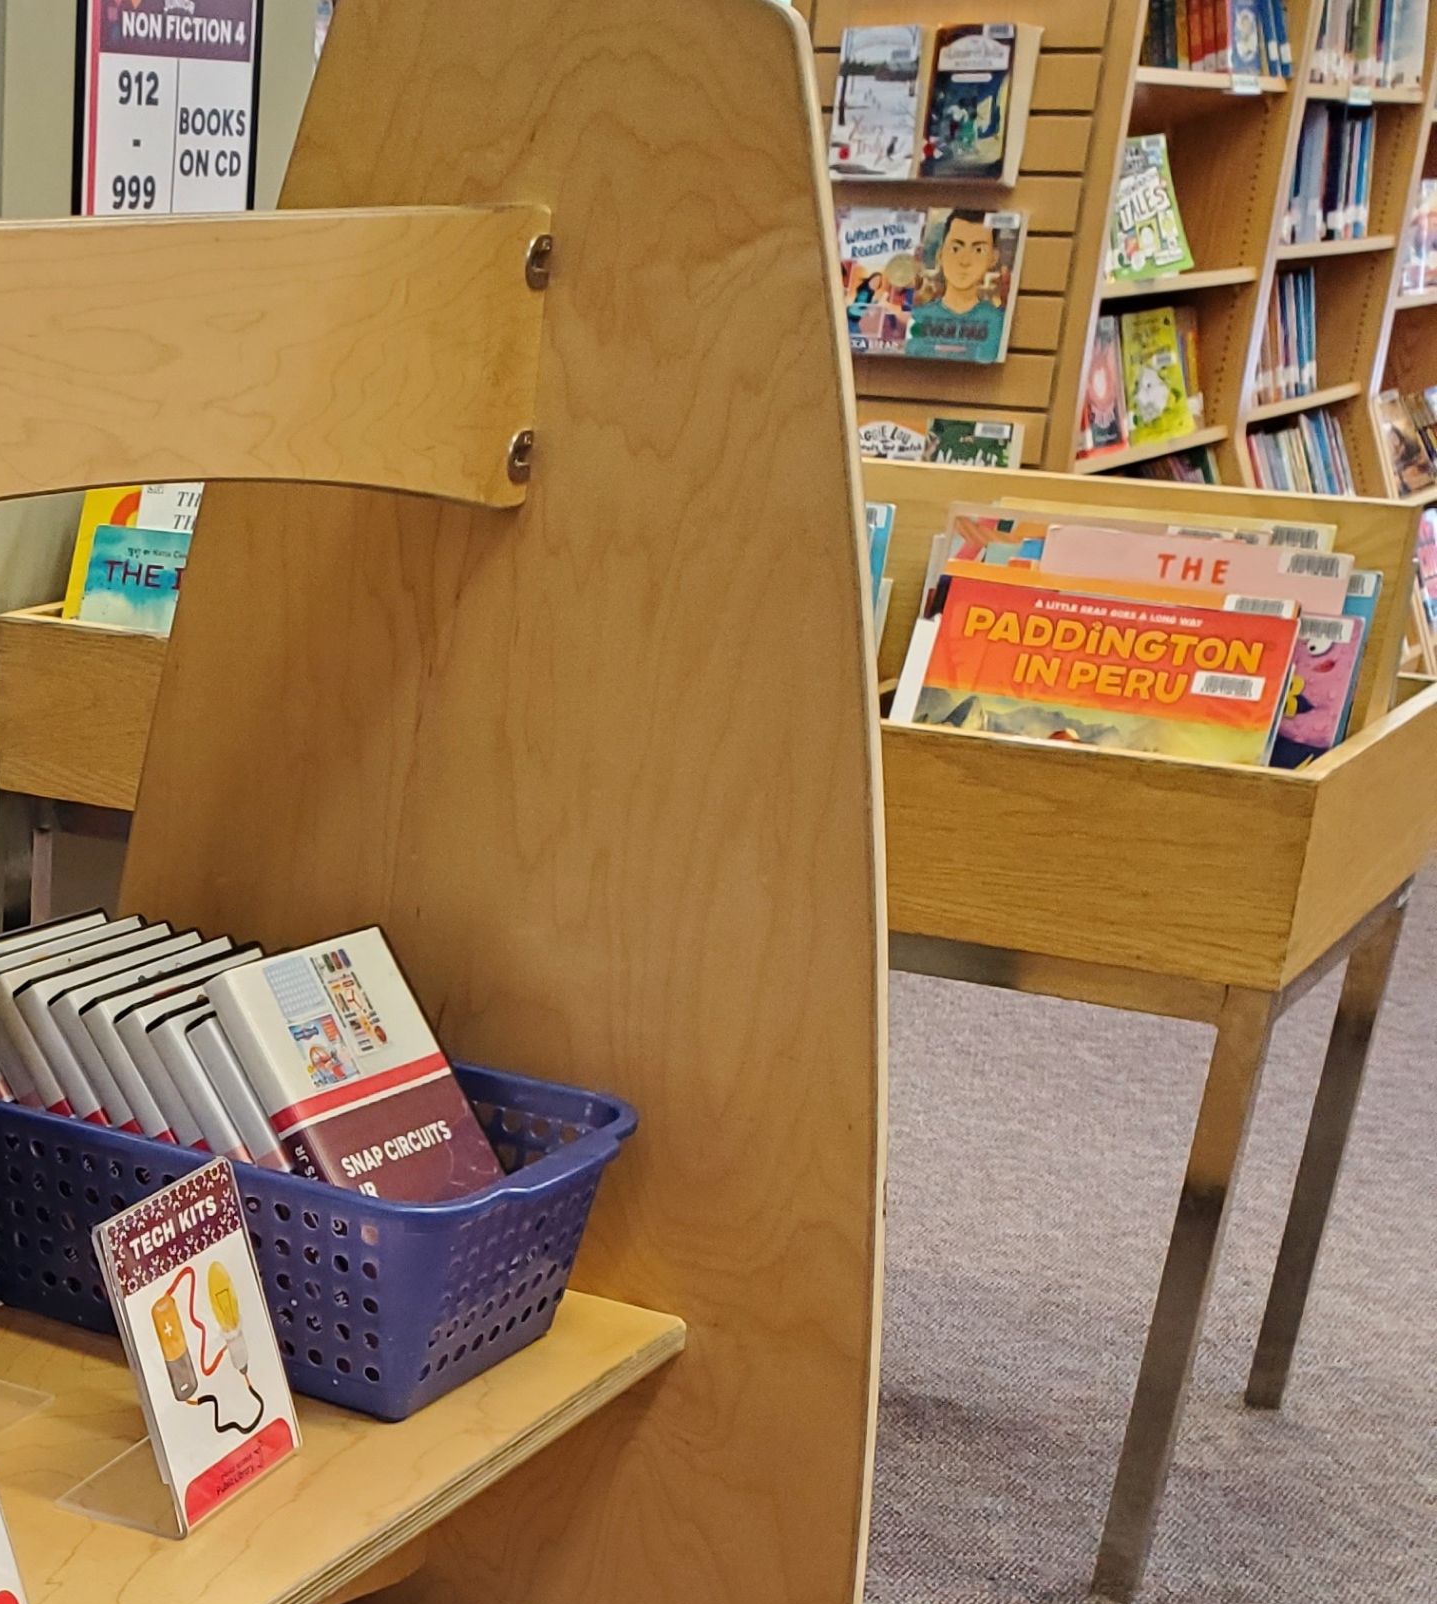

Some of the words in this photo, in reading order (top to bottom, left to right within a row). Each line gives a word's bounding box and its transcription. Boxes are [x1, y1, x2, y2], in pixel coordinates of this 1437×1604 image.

[122, 11, 162, 40] NON
[166, 15, 232, 44] FICTION
[235, 22, 246, 45] 4
[118, 70, 160, 106] 912
[179, 108, 246, 137] BOOKS
[180, 150, 208, 177] ON
[215, 150, 242, 177] CD
[112, 175, 156, 210] 999
[104, 558, 164, 588] THE
[1158, 552, 1230, 585] THE
[1046, 600, 1079, 613] LITTLE
[1150, 612, 1177, 625] LONG
[1179, 616, 1204, 628] WAY
[1014, 653, 1062, 687] IN
[1067, 660, 1189, 704] PERU
[341, 1146, 384, 1178] SNAP
[384, 1120, 452, 1161] CIRCUITS
[129, 1224, 176, 1260] TECH
[178, 1195, 217, 1233] KITS
